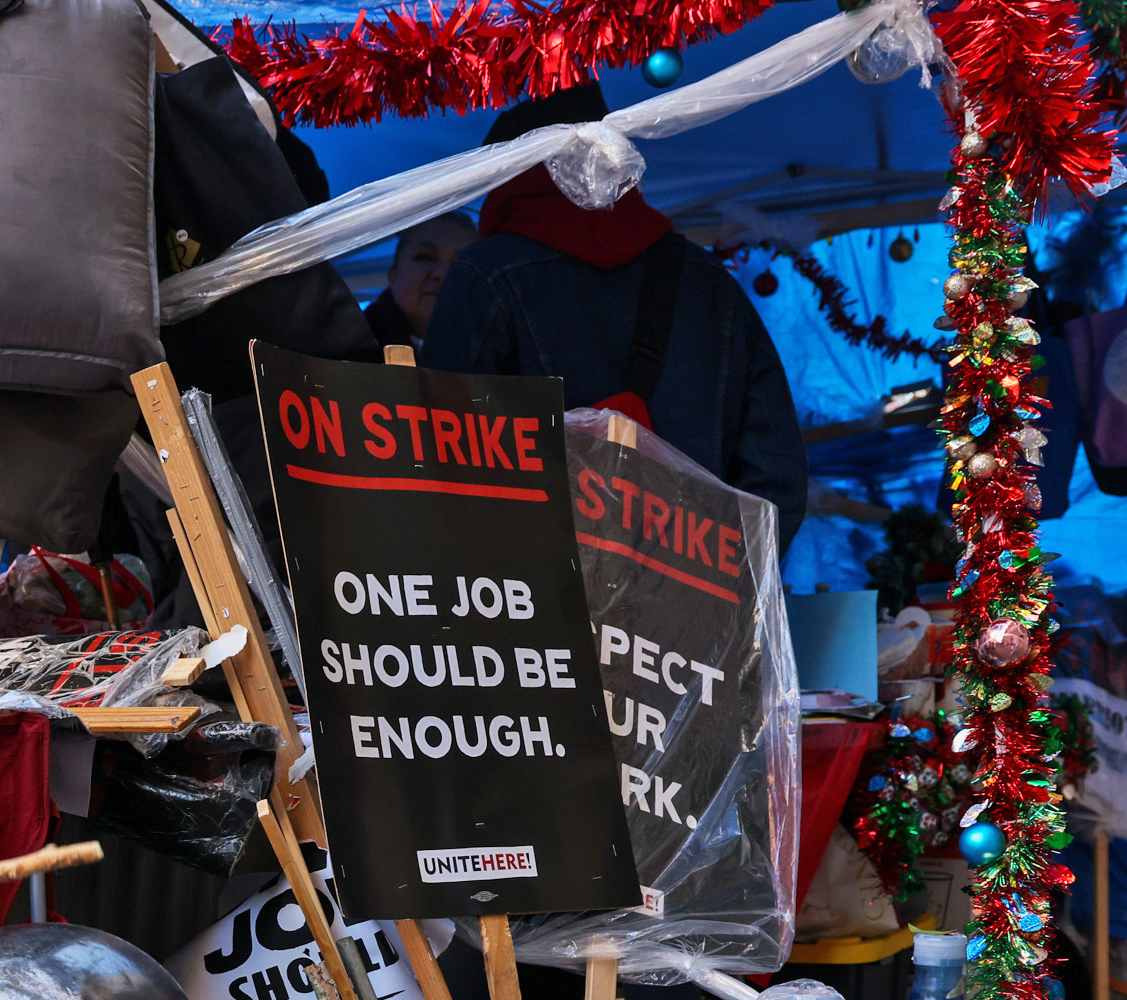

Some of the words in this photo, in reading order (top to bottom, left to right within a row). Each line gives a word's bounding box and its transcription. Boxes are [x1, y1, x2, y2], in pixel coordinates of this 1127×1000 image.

[279, 389, 346, 457] ON
[361, 402, 544, 472] STRIKE
[575, 469, 741, 578] STRIKE
[334, 571, 437, 616] ONE
[451, 576, 535, 619] JOB
[321, 638, 505, 688] SHOULD
[514, 647, 576, 689] BE
[590, 620, 725, 706] PECT
[350, 714, 566, 759] ENOUGH.
[603, 689, 667, 754] UR
[621, 762, 698, 829] RK.
[423, 852, 532, 875] UNITEHERE!
[204, 877, 370, 975] JO
